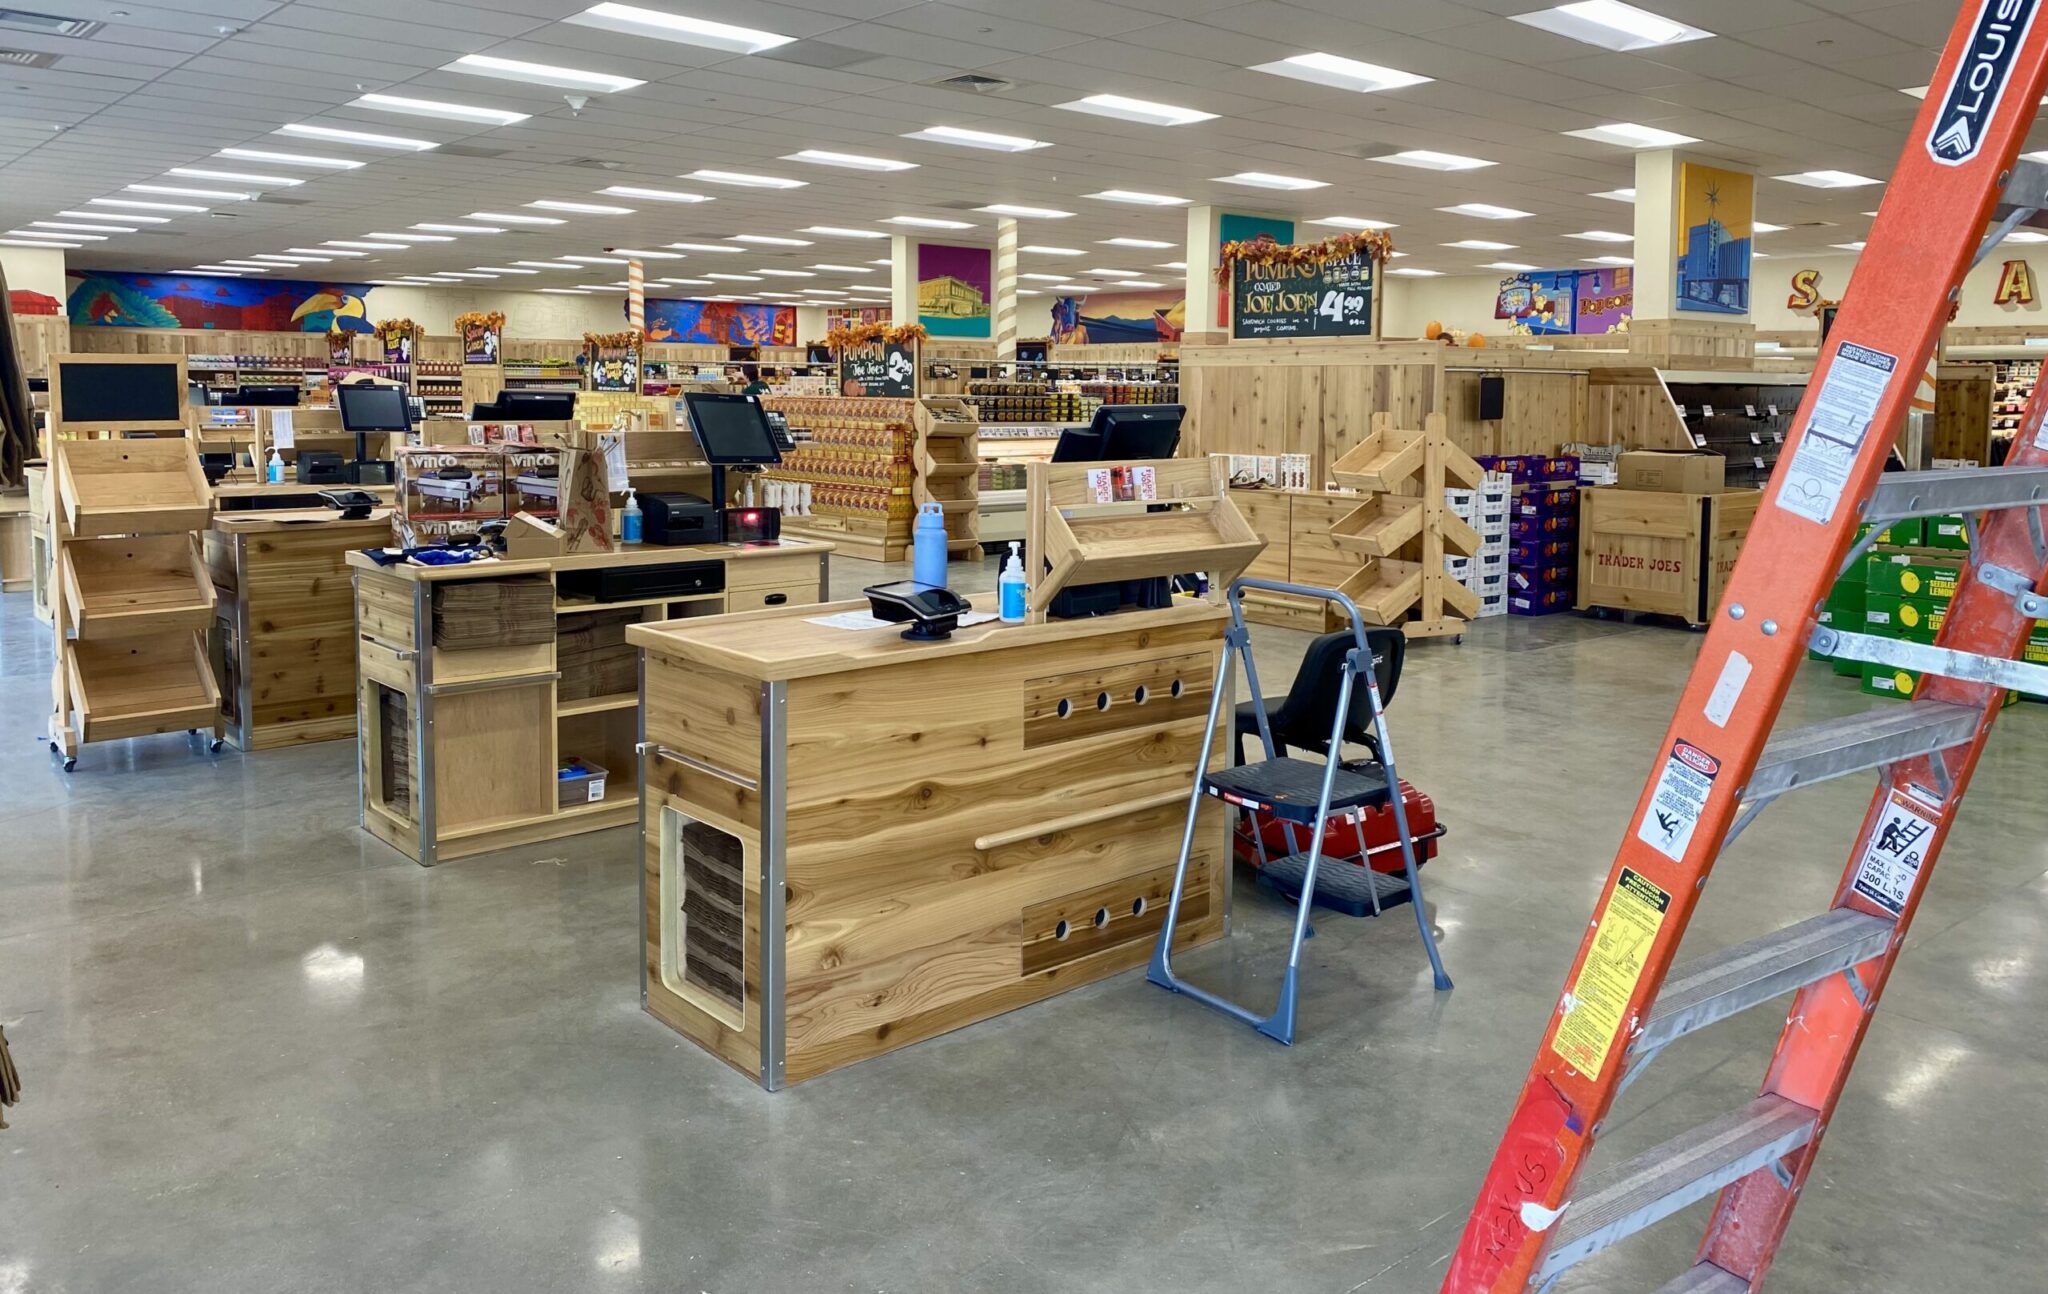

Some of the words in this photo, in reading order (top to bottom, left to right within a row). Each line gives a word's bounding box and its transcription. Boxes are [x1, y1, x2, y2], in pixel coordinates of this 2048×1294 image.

[1994, 260, 2034, 305] A
[1244, 289, 1274, 315] JOE
[842, 341, 885, 362] PUMPKIN
[1845, 344, 1891, 362] INSTRUCTIONS
[1598, 554, 1644, 570] TRADER
[1716, 560, 1737, 574] TRAD
[1930, 587, 1954, 597] LEMON
[1680, 752, 1709, 771] PELIGRO
[1682, 746, 1711, 766] DANGER
[1862, 870, 1881, 886] 300
[1867, 862, 1901, 885] CAPACY
[1887, 866, 1907, 881] LD
[1633, 874, 1661, 896] CAUTION
[1625, 884, 1660, 909] ATTENTION
